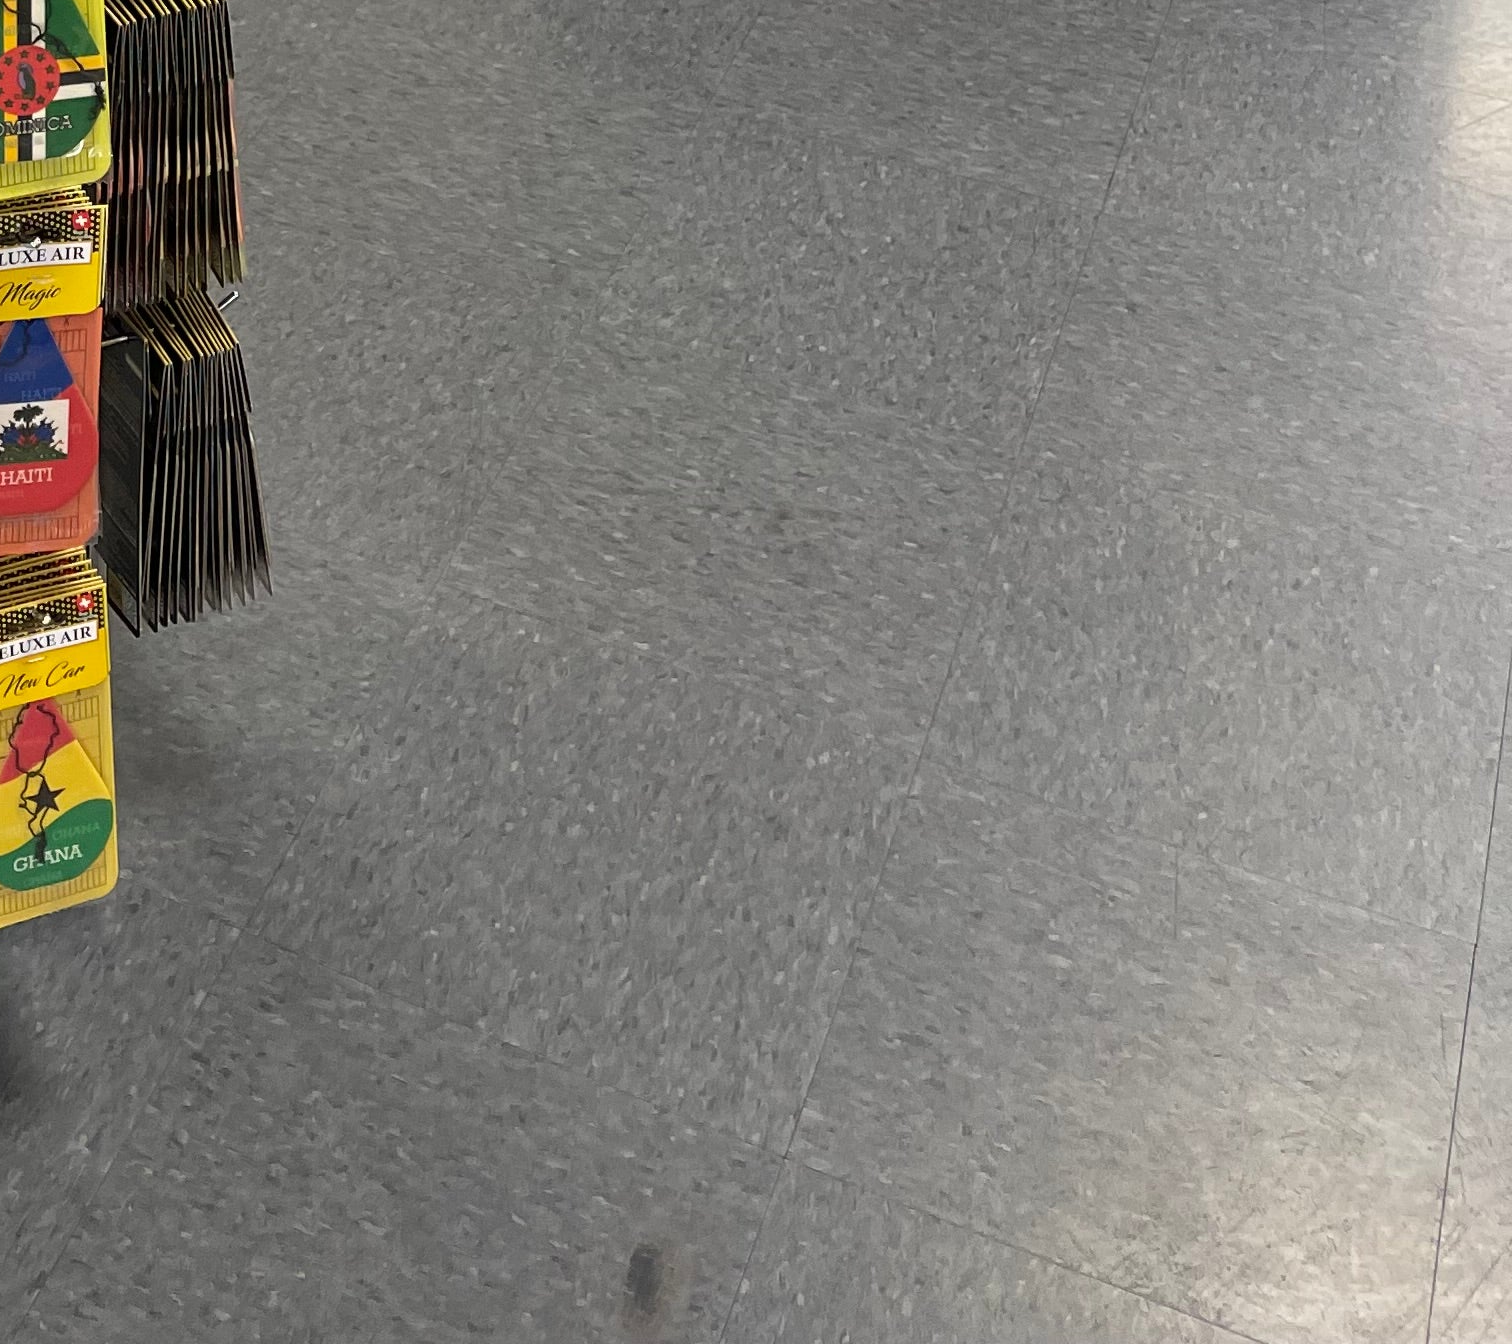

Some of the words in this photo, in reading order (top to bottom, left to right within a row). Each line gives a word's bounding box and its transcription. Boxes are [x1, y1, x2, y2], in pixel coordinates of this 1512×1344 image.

[49, 245, 85, 264] AIR
[0, 466, 54, 487] HAITI
[61, 624, 93, 646] AIR
[47, 661, 85, 687] Car
[12, 843, 84, 875] GHANA
